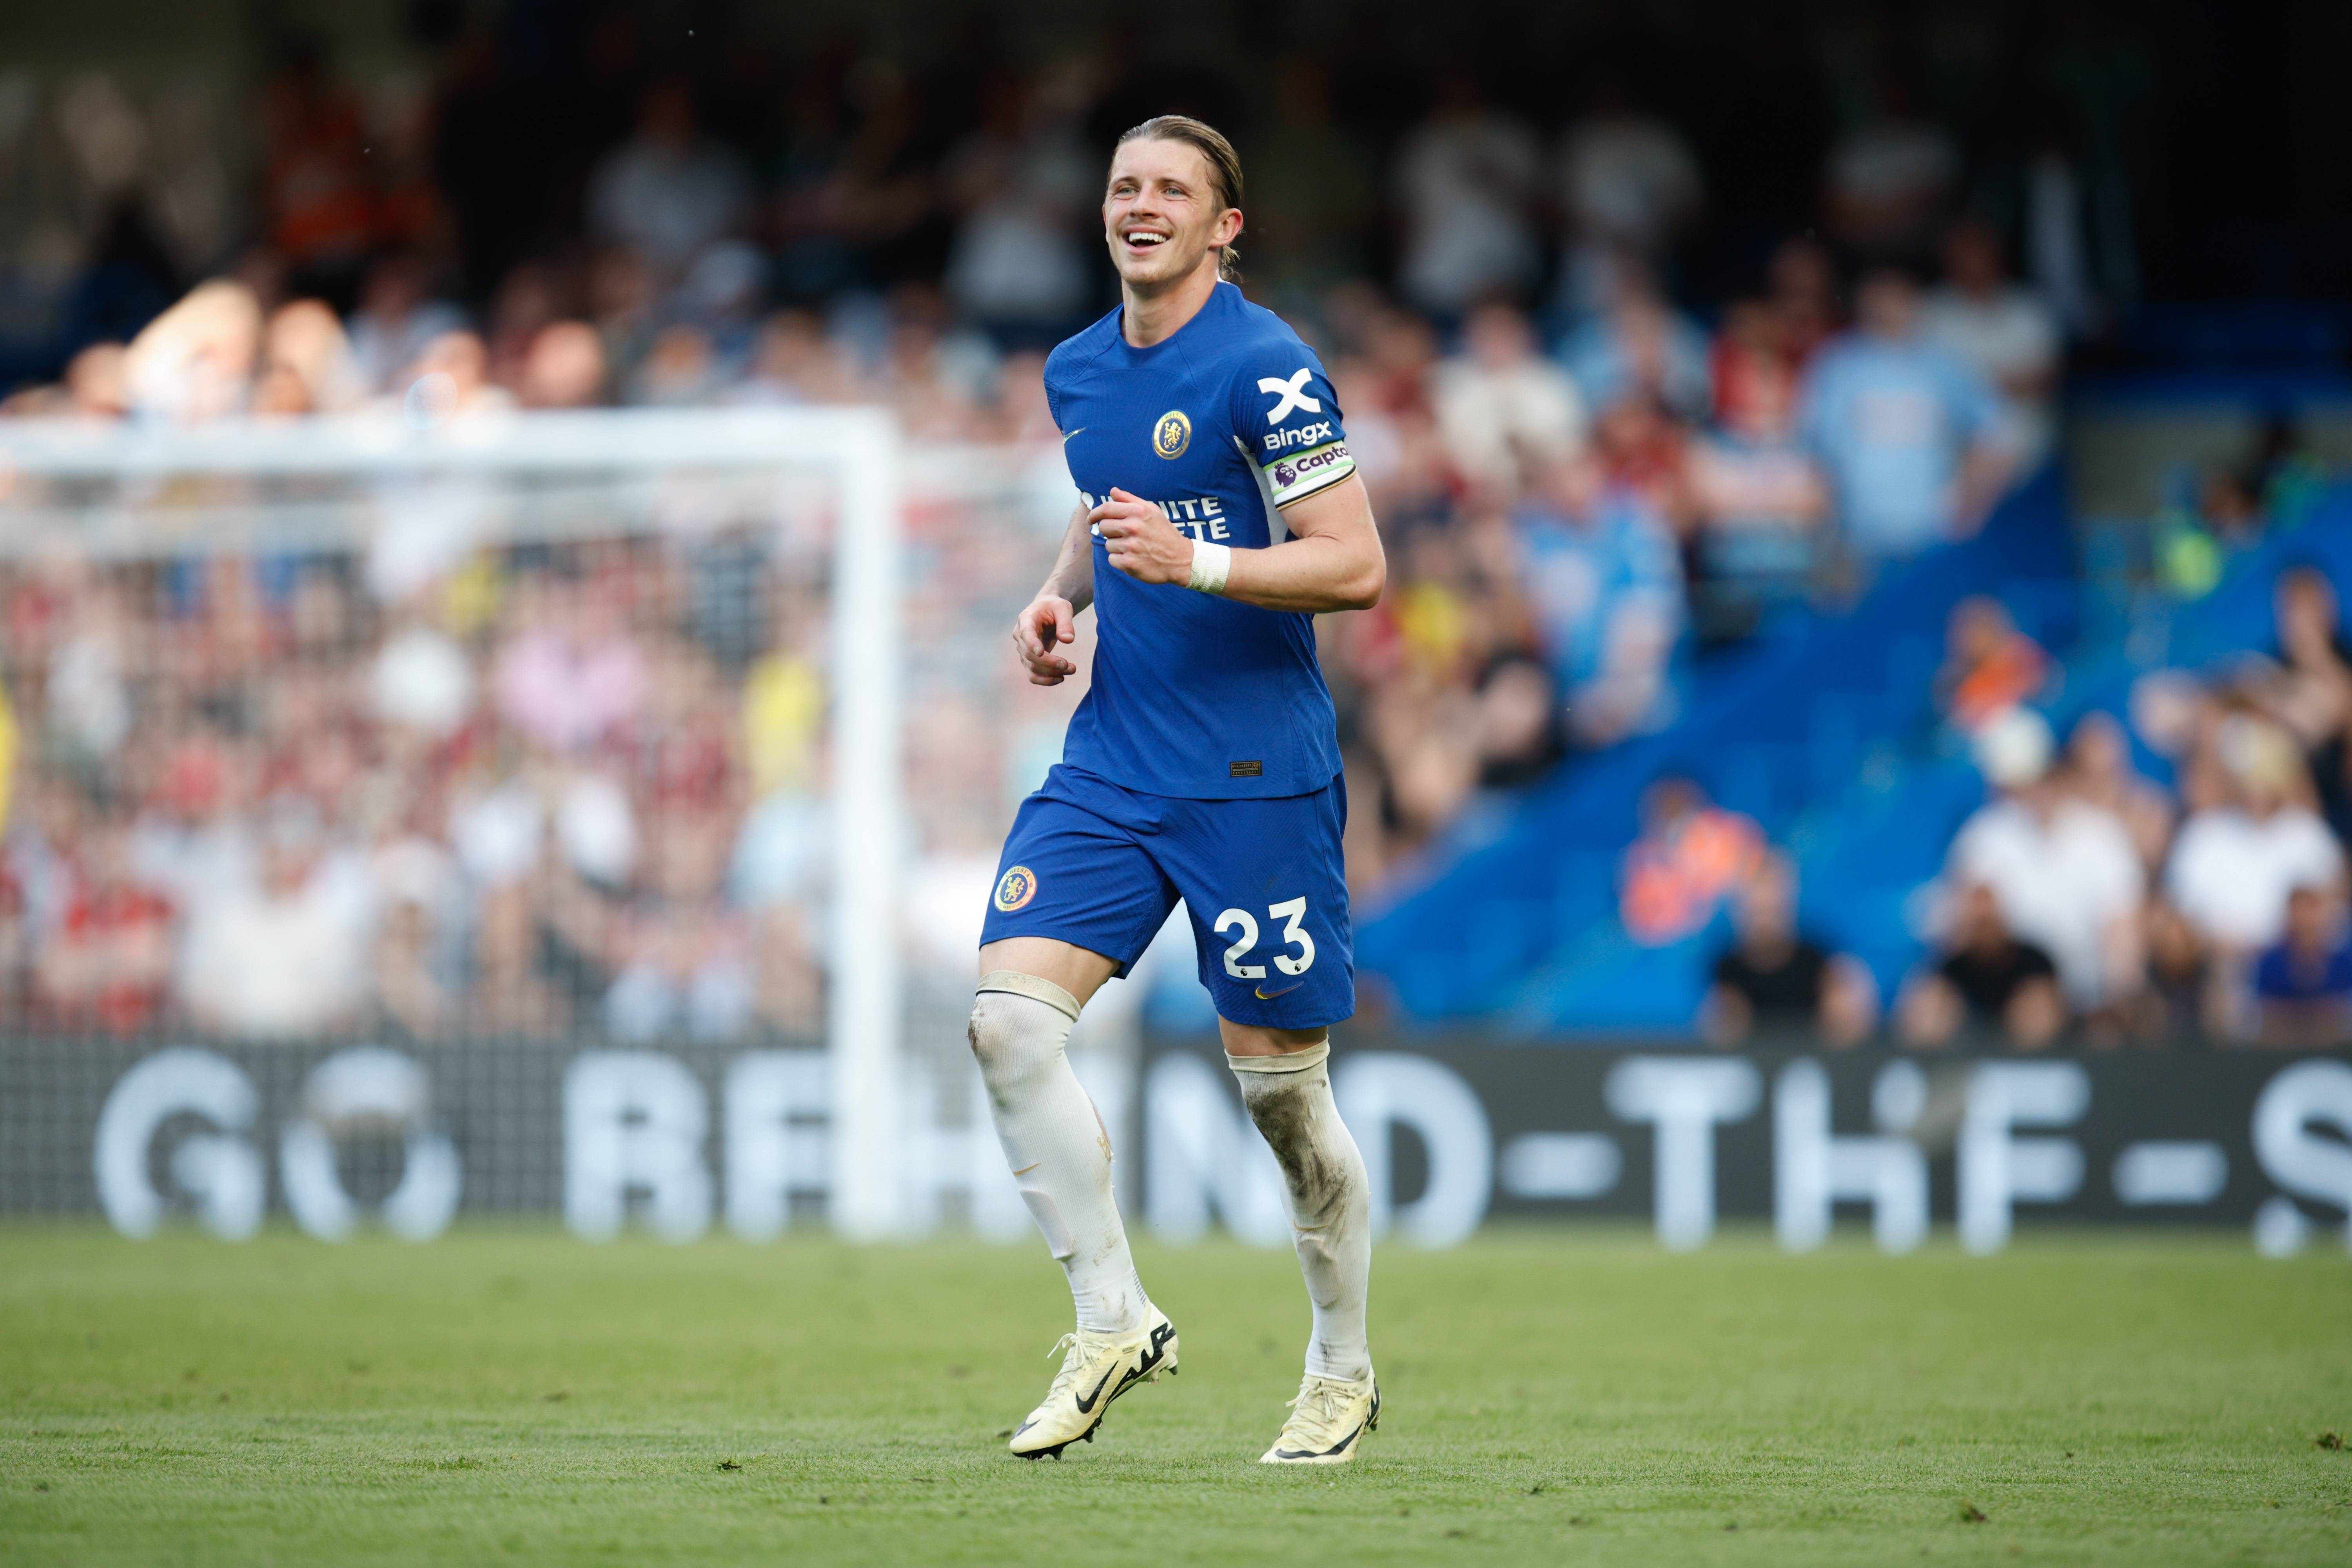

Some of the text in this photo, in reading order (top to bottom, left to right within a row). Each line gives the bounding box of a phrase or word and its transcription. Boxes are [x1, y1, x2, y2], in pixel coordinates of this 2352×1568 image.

[1006, 867, 1031, 878] CHELSEA
[1214, 896, 1316, 978] 23
[95, 1047, 462, 1241] GO
